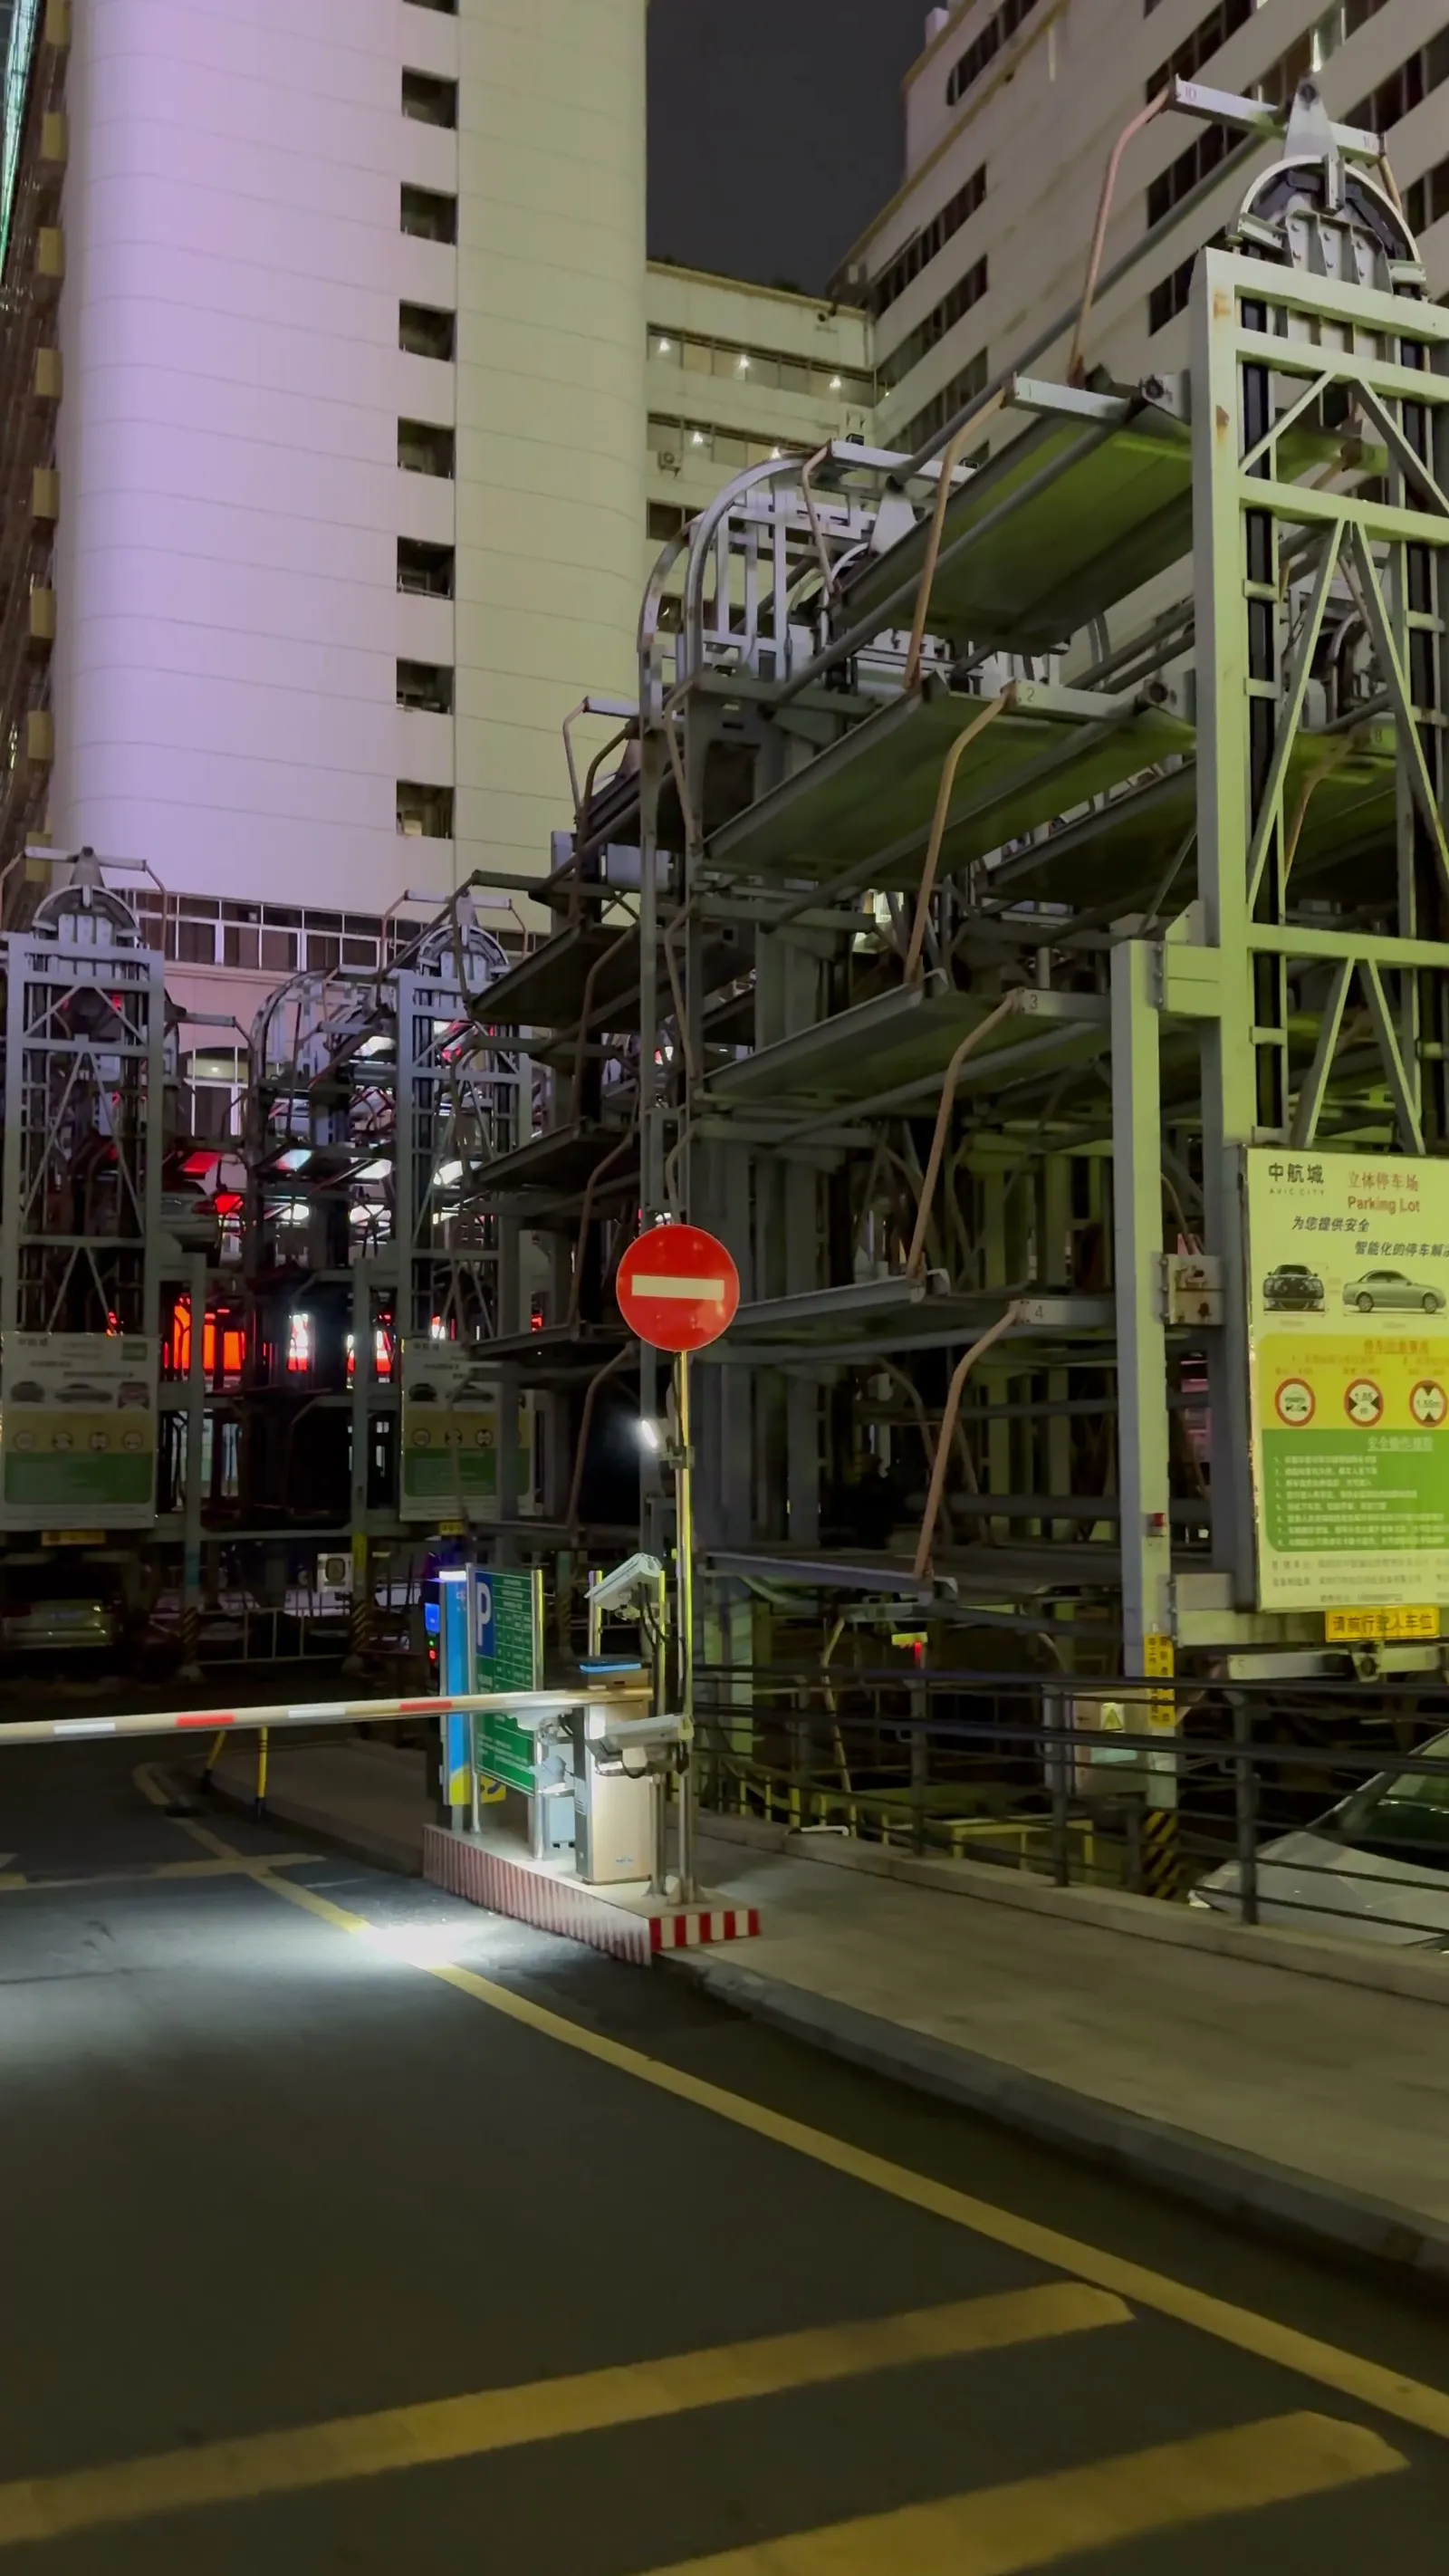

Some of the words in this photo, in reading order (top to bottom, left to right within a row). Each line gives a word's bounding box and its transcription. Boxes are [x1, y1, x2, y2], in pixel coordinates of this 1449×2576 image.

[1185, 87, 1196, 102] 10
[1026, 687, 1035, 702] 2
[1031, 994, 1039, 1010] 3
[1268, 1162, 1325, 1184] 中航城
[1348, 1171, 1419, 1192] 立体停车场
[1348, 1196, 1396, 1215] Parking
[1400, 1197, 1420, 1213] Lot
[1291, 1216, 1370, 1233] 为您提供安全
[1034, 1305, 1043, 1319] 4
[476, 1581, 492, 1647] P
